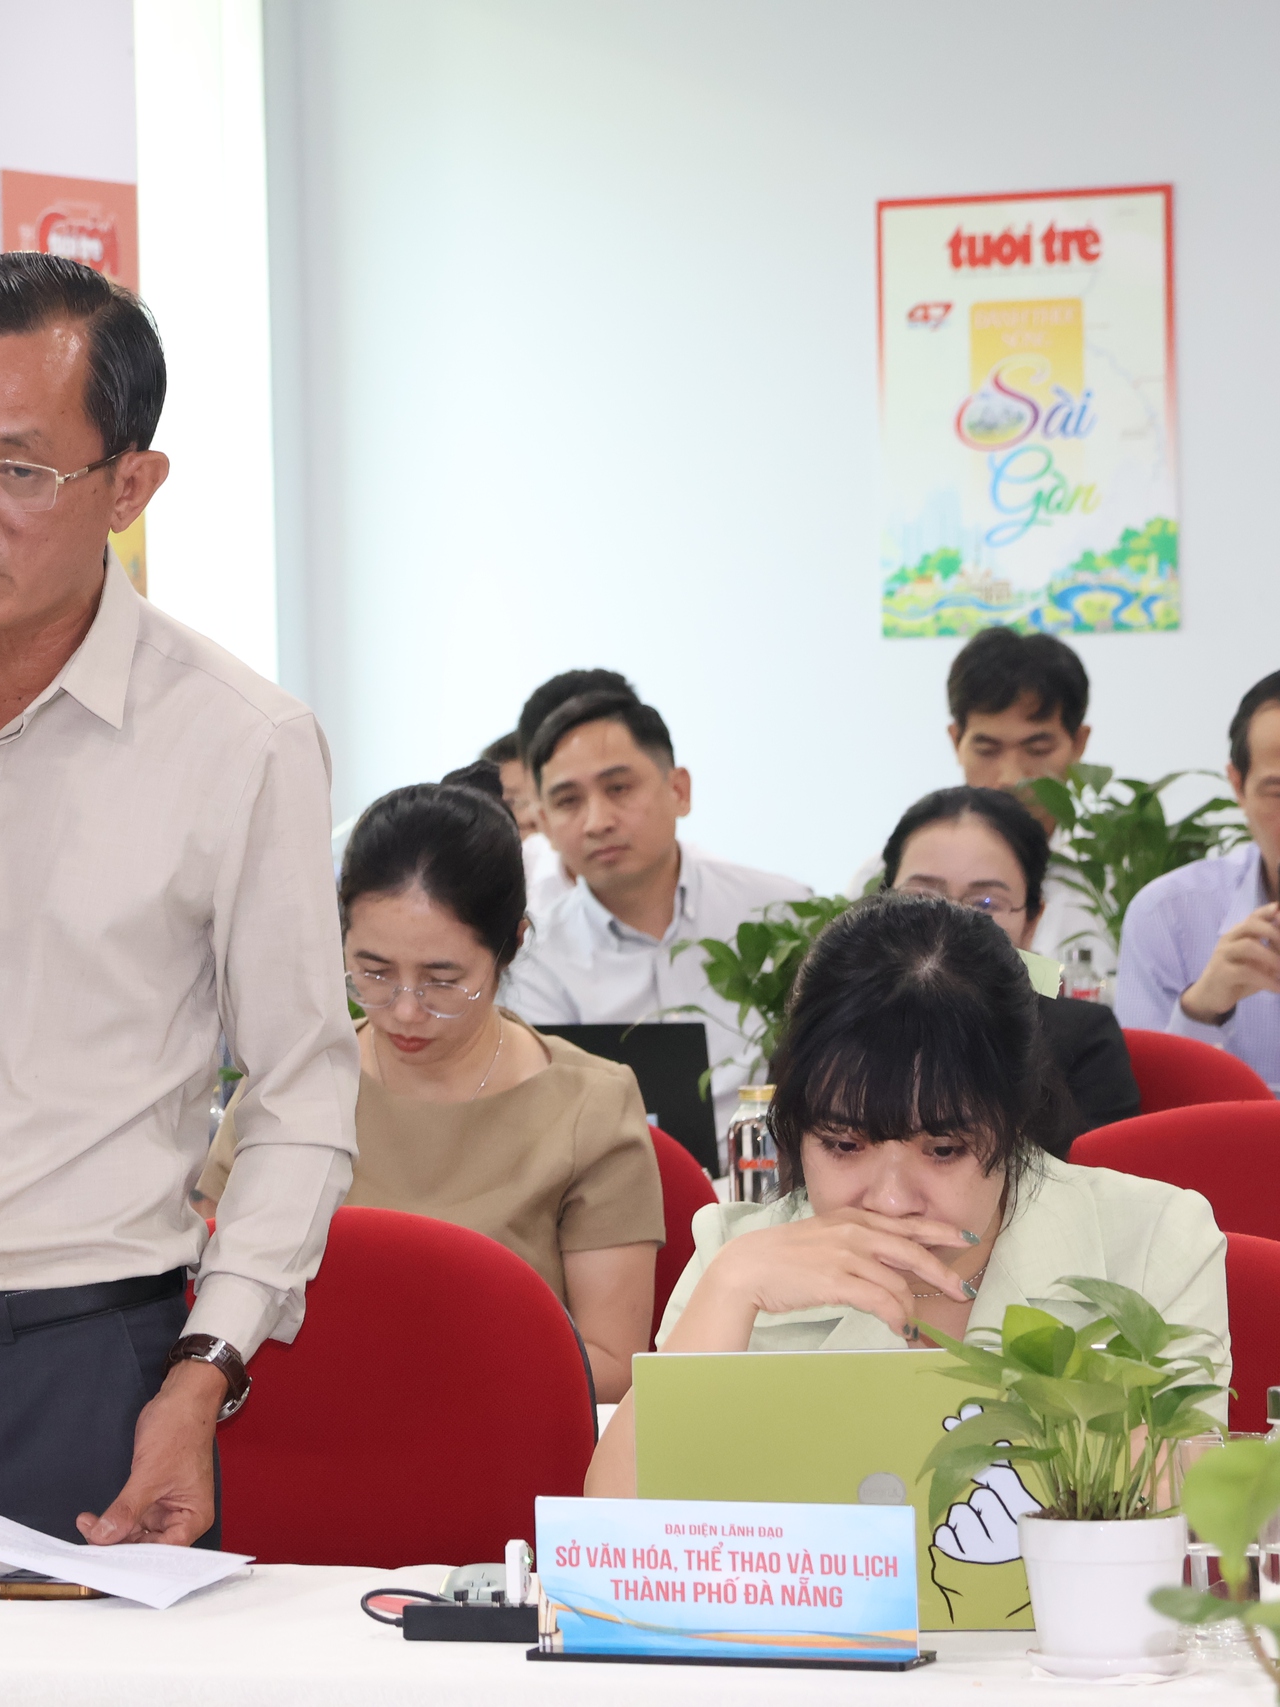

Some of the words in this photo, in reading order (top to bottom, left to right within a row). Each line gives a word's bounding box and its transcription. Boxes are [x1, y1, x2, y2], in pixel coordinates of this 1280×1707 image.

[954, 354, 1097, 452] Sài
[664, 1523, 685, 1538] ĐẠI
[689, 1523, 718, 1538] DIỆN
[721, 1523, 754, 1538] LÃNH
[758, 1526, 784, 1540] ĐẠO
[555, 1539, 581, 1568] SỞ
[586, 1542, 626, 1569] VĂN
[632, 1544, 678, 1573] HÓA,
[684, 1541, 724, 1572] THỂ
[727, 1550, 782, 1574] THAO
[787, 1548, 815, 1575] VÀ
[820, 1553, 847, 1577] DU
[853, 1554, 898, 1582] LỊCH
[610, 1576, 686, 1603] THÀNH
[693, 1576, 740, 1605] PHỐ
[744, 1579, 774, 1606] ĐÀ
[781, 1576, 843, 1608] NẴNG
